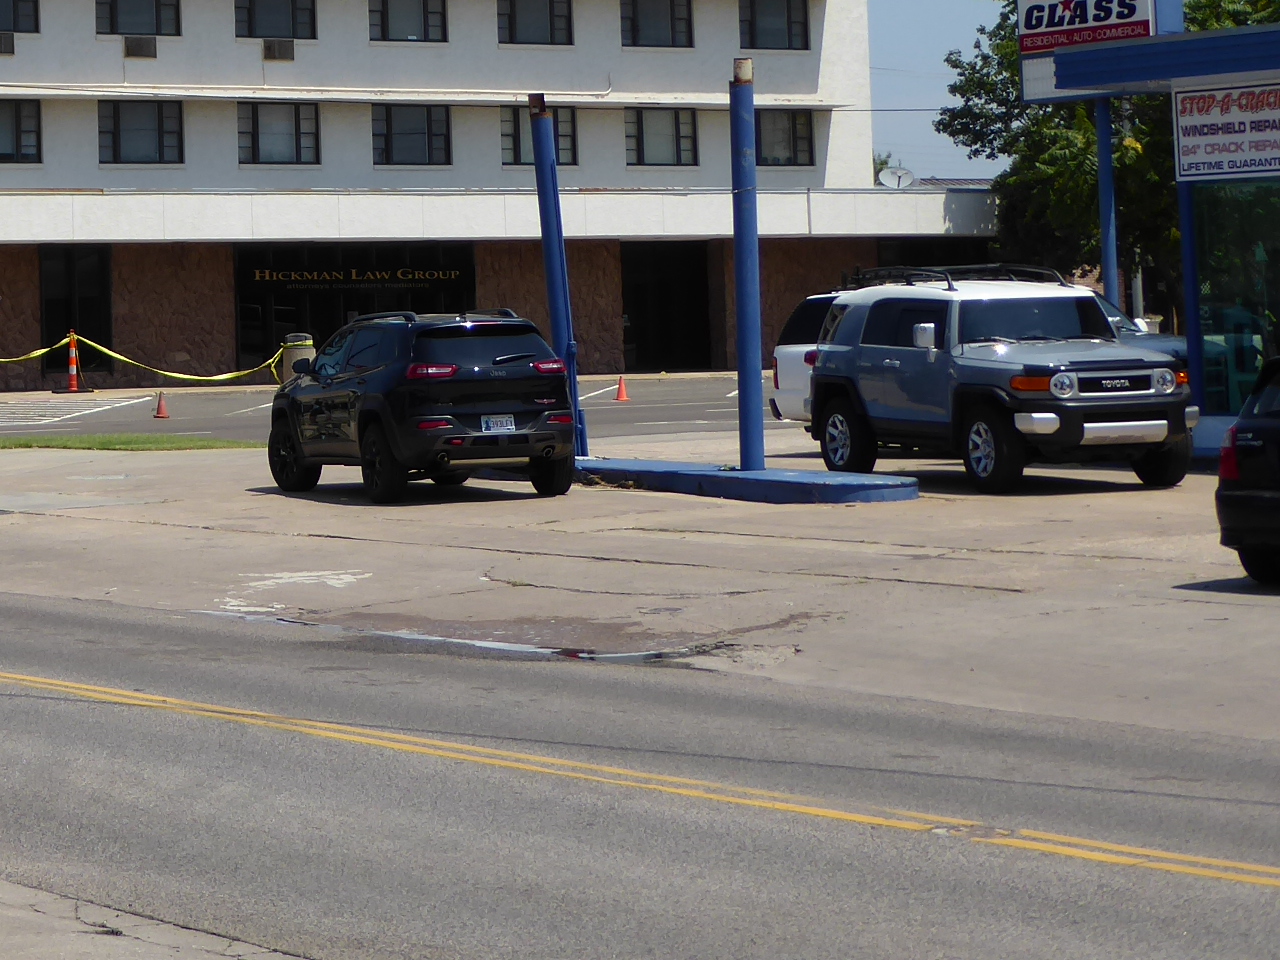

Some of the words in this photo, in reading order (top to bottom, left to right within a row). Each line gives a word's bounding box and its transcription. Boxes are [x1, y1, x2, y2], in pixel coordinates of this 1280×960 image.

[1023, 34, 1069, 47] RESIDENTIAL
[1072, 30, 1093, 41] AUTO
[1096, 24, 1147, 39] COMMERCIAL
[1181, 121, 1246, 137] WINDSHIELD
[1204, 141, 1245, 155] CRACK
[1182, 160, 1224, 172] LIFETIME
[254, 269, 344, 280] HICKMAN
[351, 268, 392, 280] LAW
[396, 268, 460, 279] GROUP
[1101, 379, 1130, 388] TOYOTA
